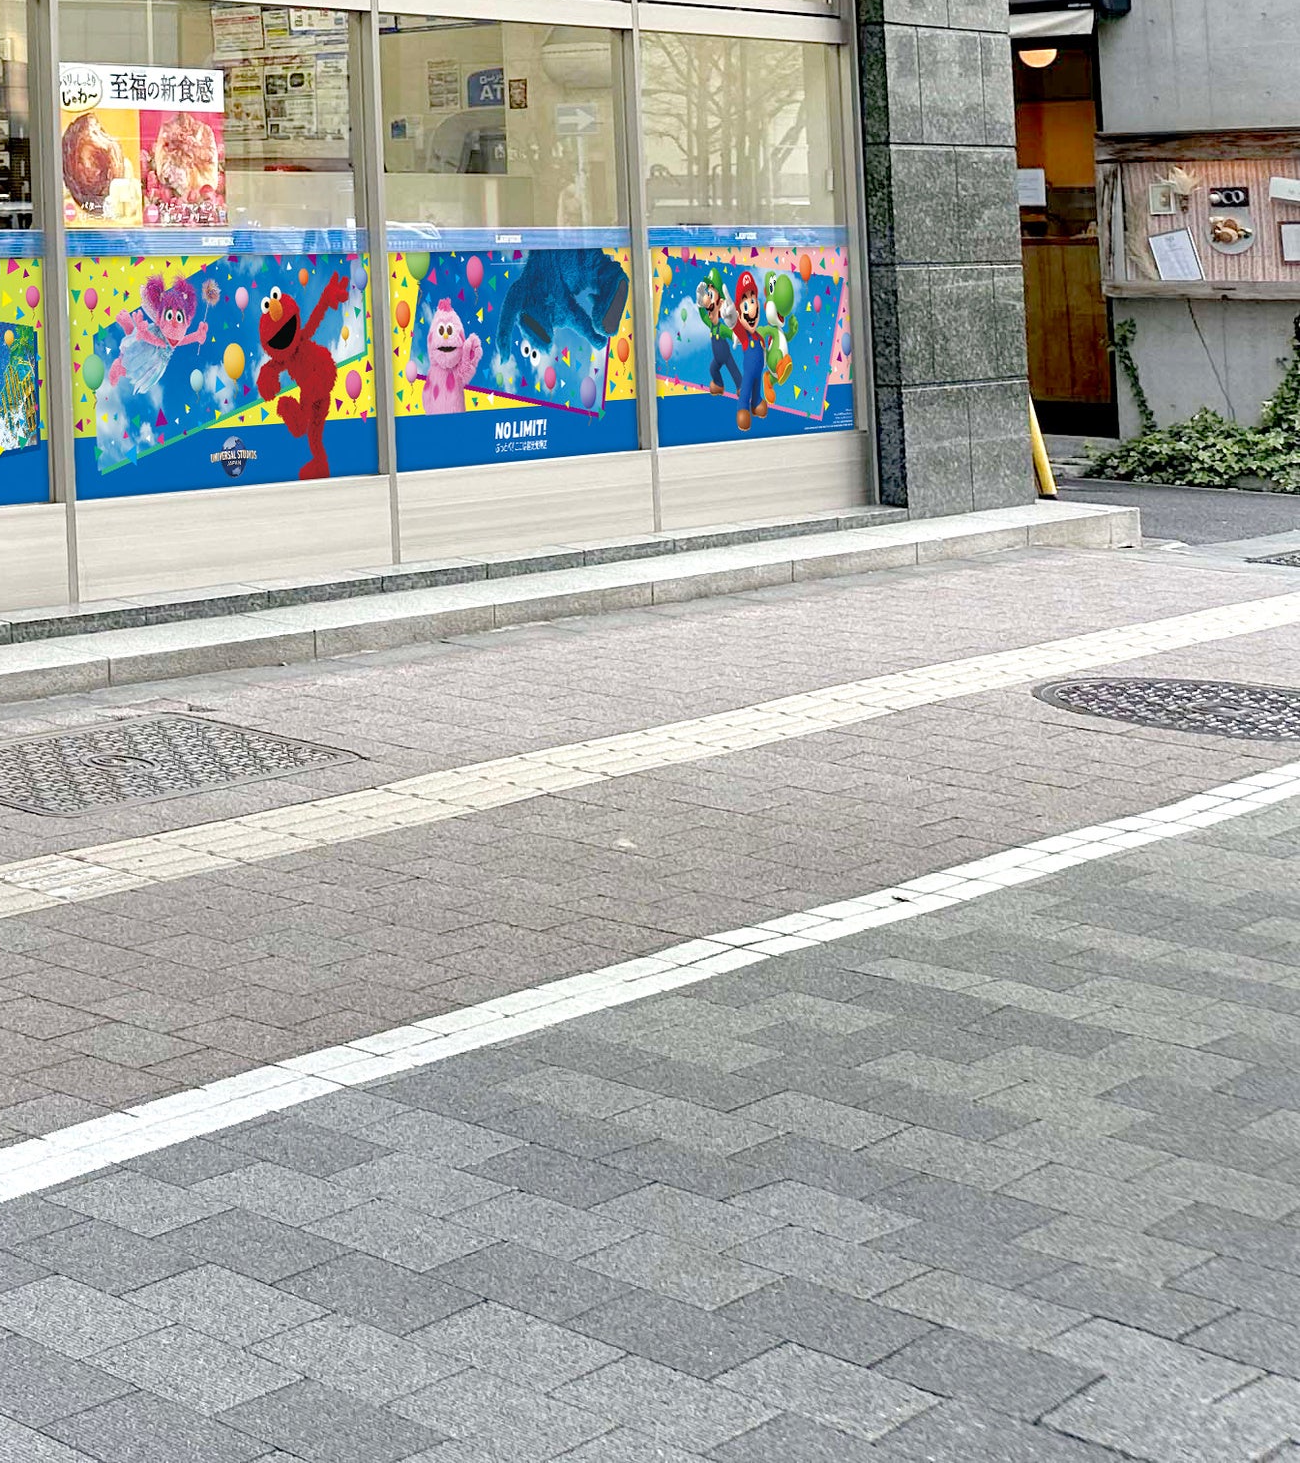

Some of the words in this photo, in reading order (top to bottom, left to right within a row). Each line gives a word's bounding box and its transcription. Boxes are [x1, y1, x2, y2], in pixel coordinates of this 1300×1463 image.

[109, 73, 214, 103] 至福の新食感
[495, 422, 511, 440] NO
[513, 419, 547, 438] LIMIT!
